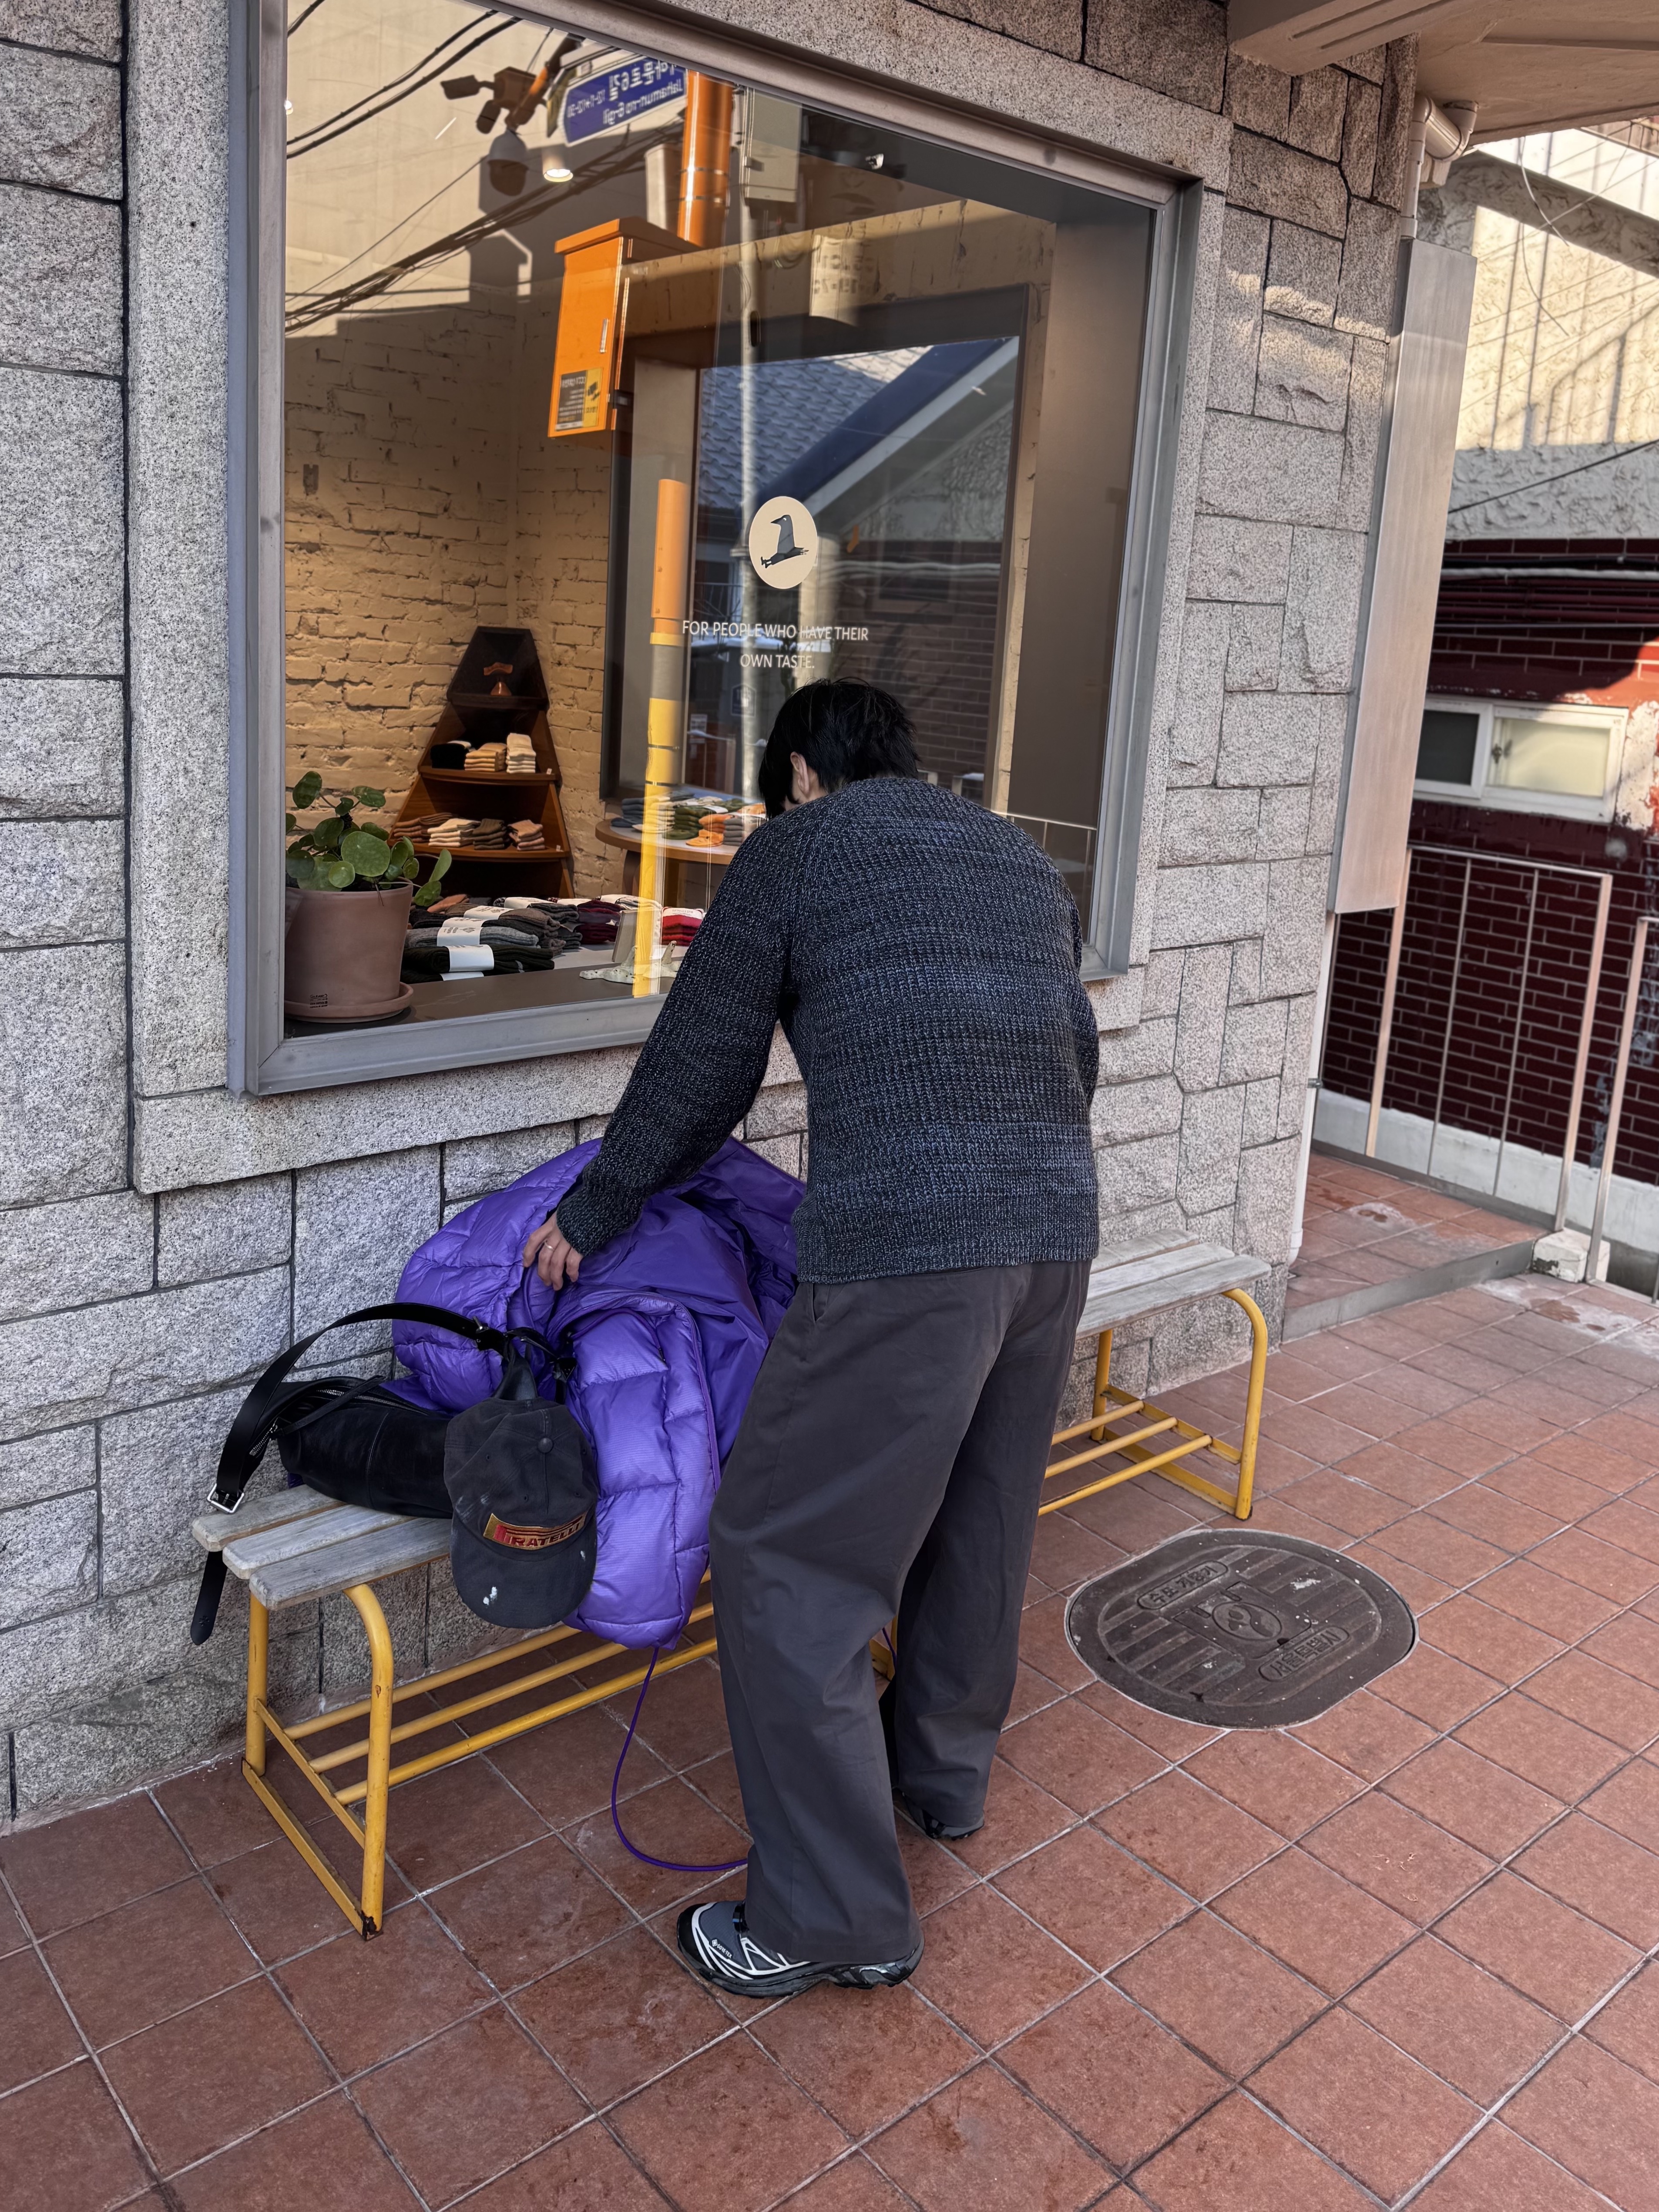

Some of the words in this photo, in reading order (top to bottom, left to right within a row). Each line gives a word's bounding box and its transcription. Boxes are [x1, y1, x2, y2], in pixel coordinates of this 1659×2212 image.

[682, 620, 709, 636] FOR
[713, 622, 762, 637] PEOPLE
[765, 624, 796, 639] WHO
[800, 625, 832, 639] HAVE
[834, 626, 869, 641] THEIR
[740, 653, 772, 668] OWN
[776, 655, 815, 669] TASTE.
[717, 1943, 732, 1959] GORE-TEX
